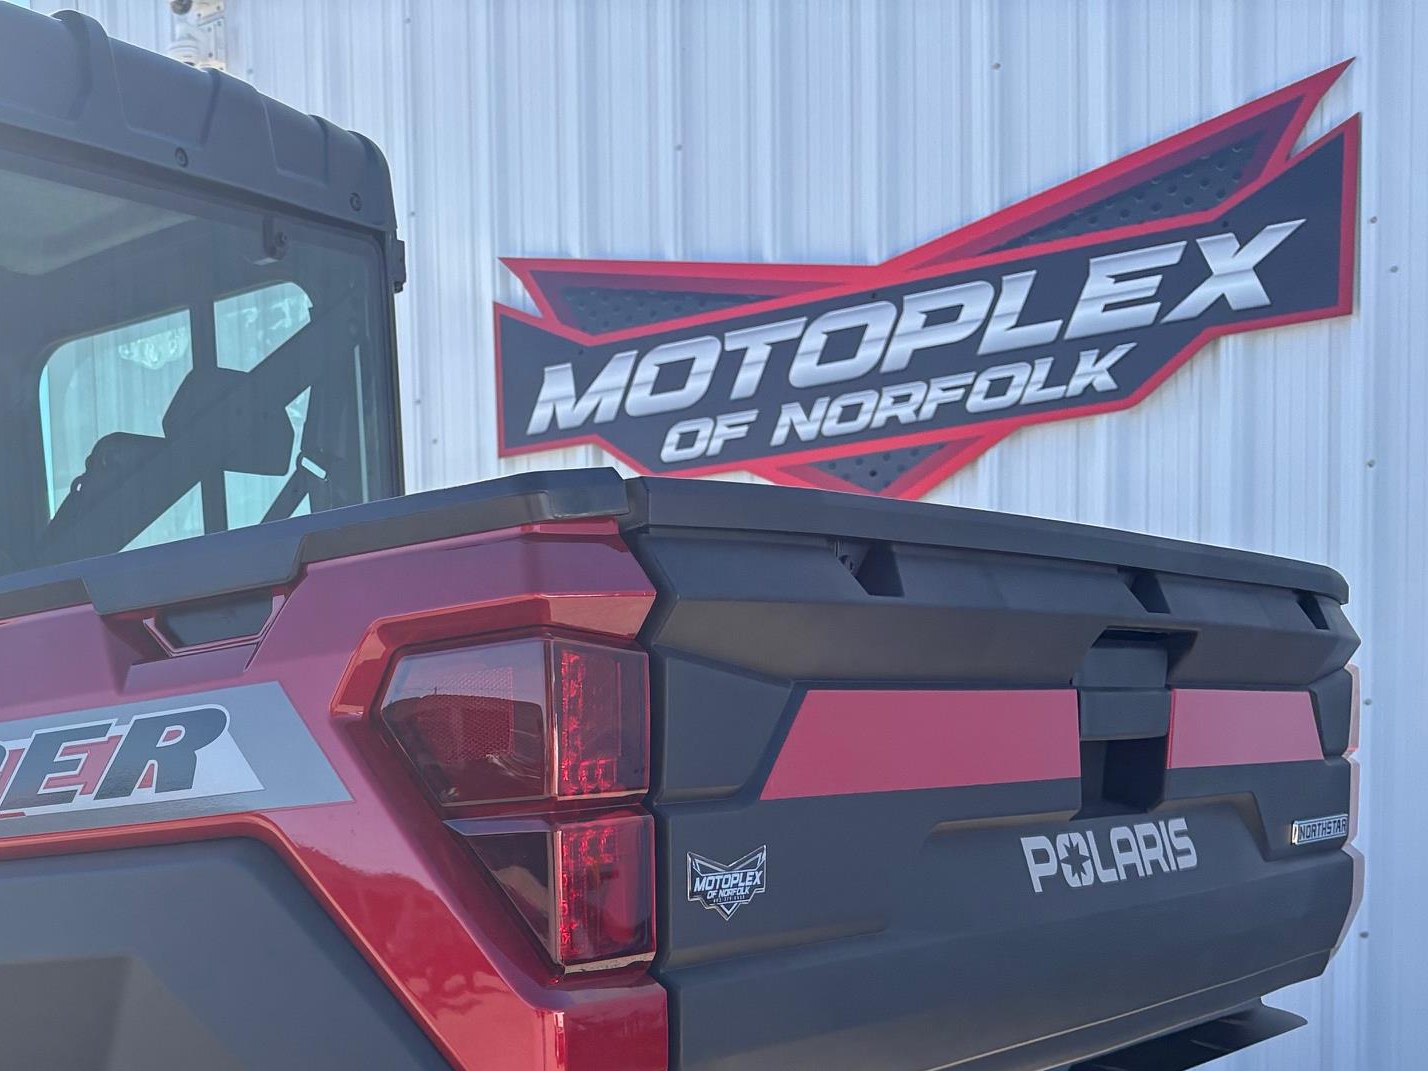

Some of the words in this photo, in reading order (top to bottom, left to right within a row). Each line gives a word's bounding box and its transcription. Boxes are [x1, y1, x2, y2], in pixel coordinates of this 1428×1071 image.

[527, 218, 1306, 437] MOTOPLEX
[659, 410, 759, 464] OF
[769, 343, 1137, 448] NORFOLK
[1299, 818, 1348, 841] NORTHSTAR
[1020, 817, 1198, 893] POLARIS
[694, 870, 763, 892] MOTOPLEX
[706, 889, 718, 900] OF
[718, 886, 751, 899] NORFOLK
